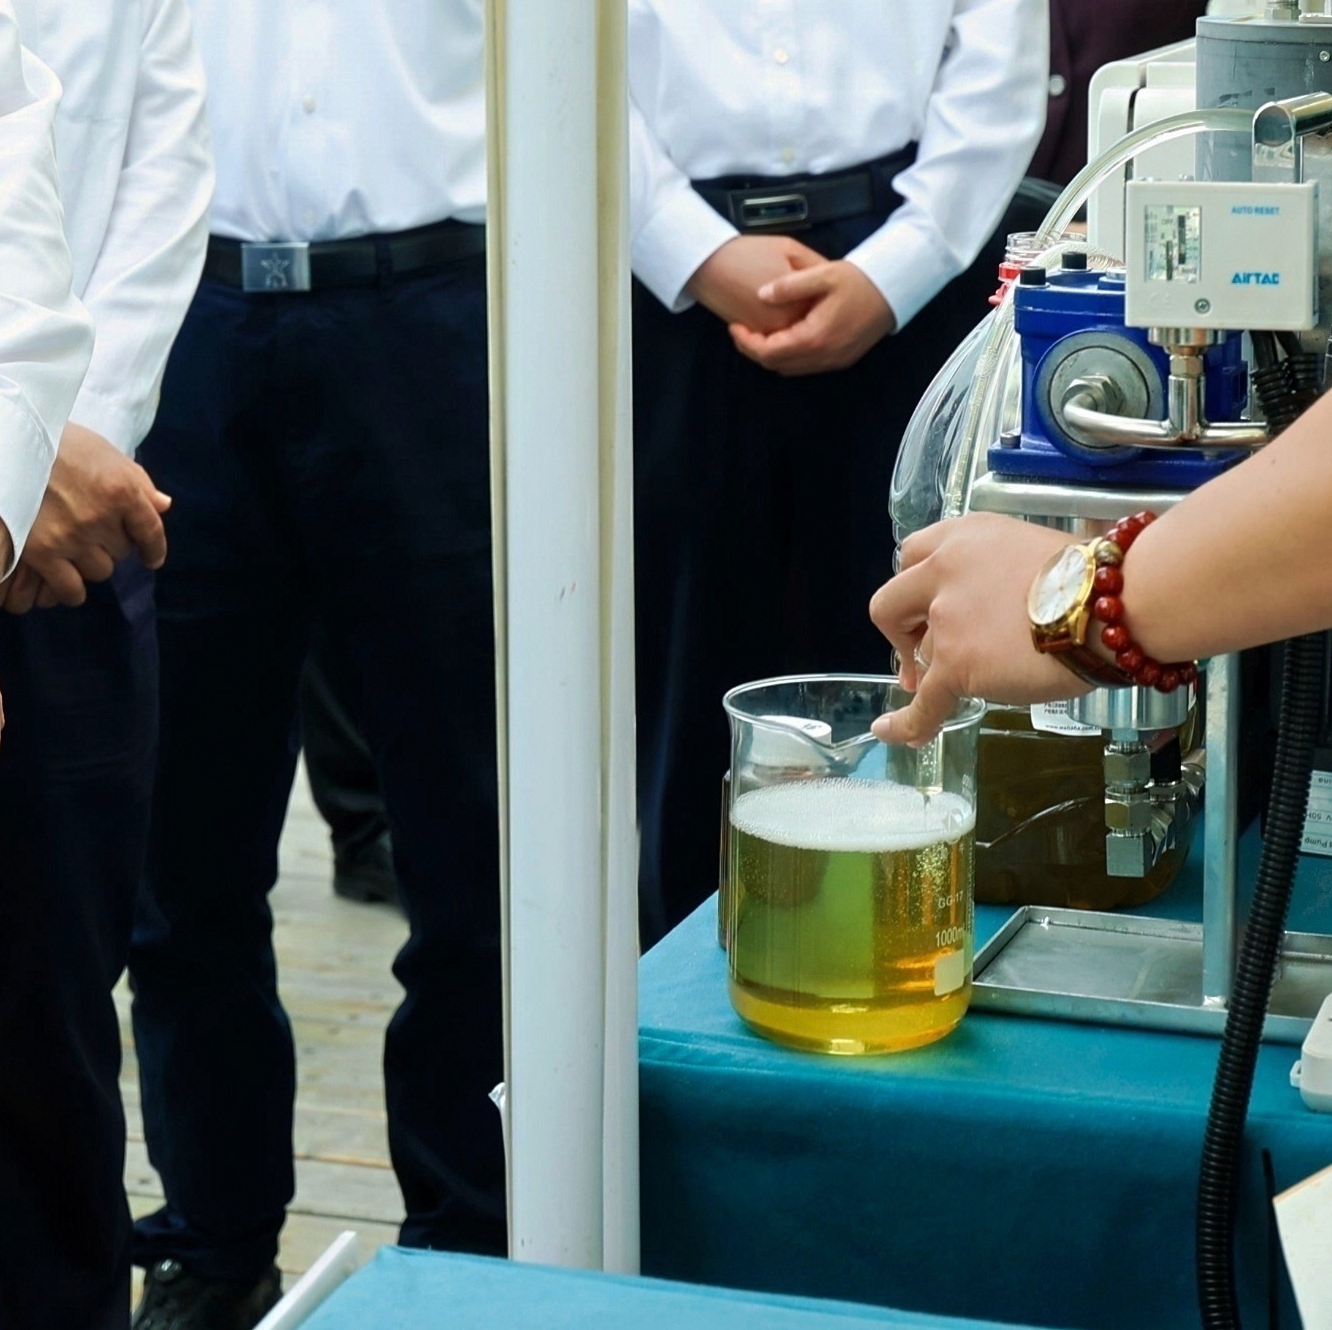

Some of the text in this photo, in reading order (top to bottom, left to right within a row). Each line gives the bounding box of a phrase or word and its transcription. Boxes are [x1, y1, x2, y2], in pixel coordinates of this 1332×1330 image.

[1231, 206, 1280, 215] AUTO RESET
[1304, 836, 1328, 849] Pump
